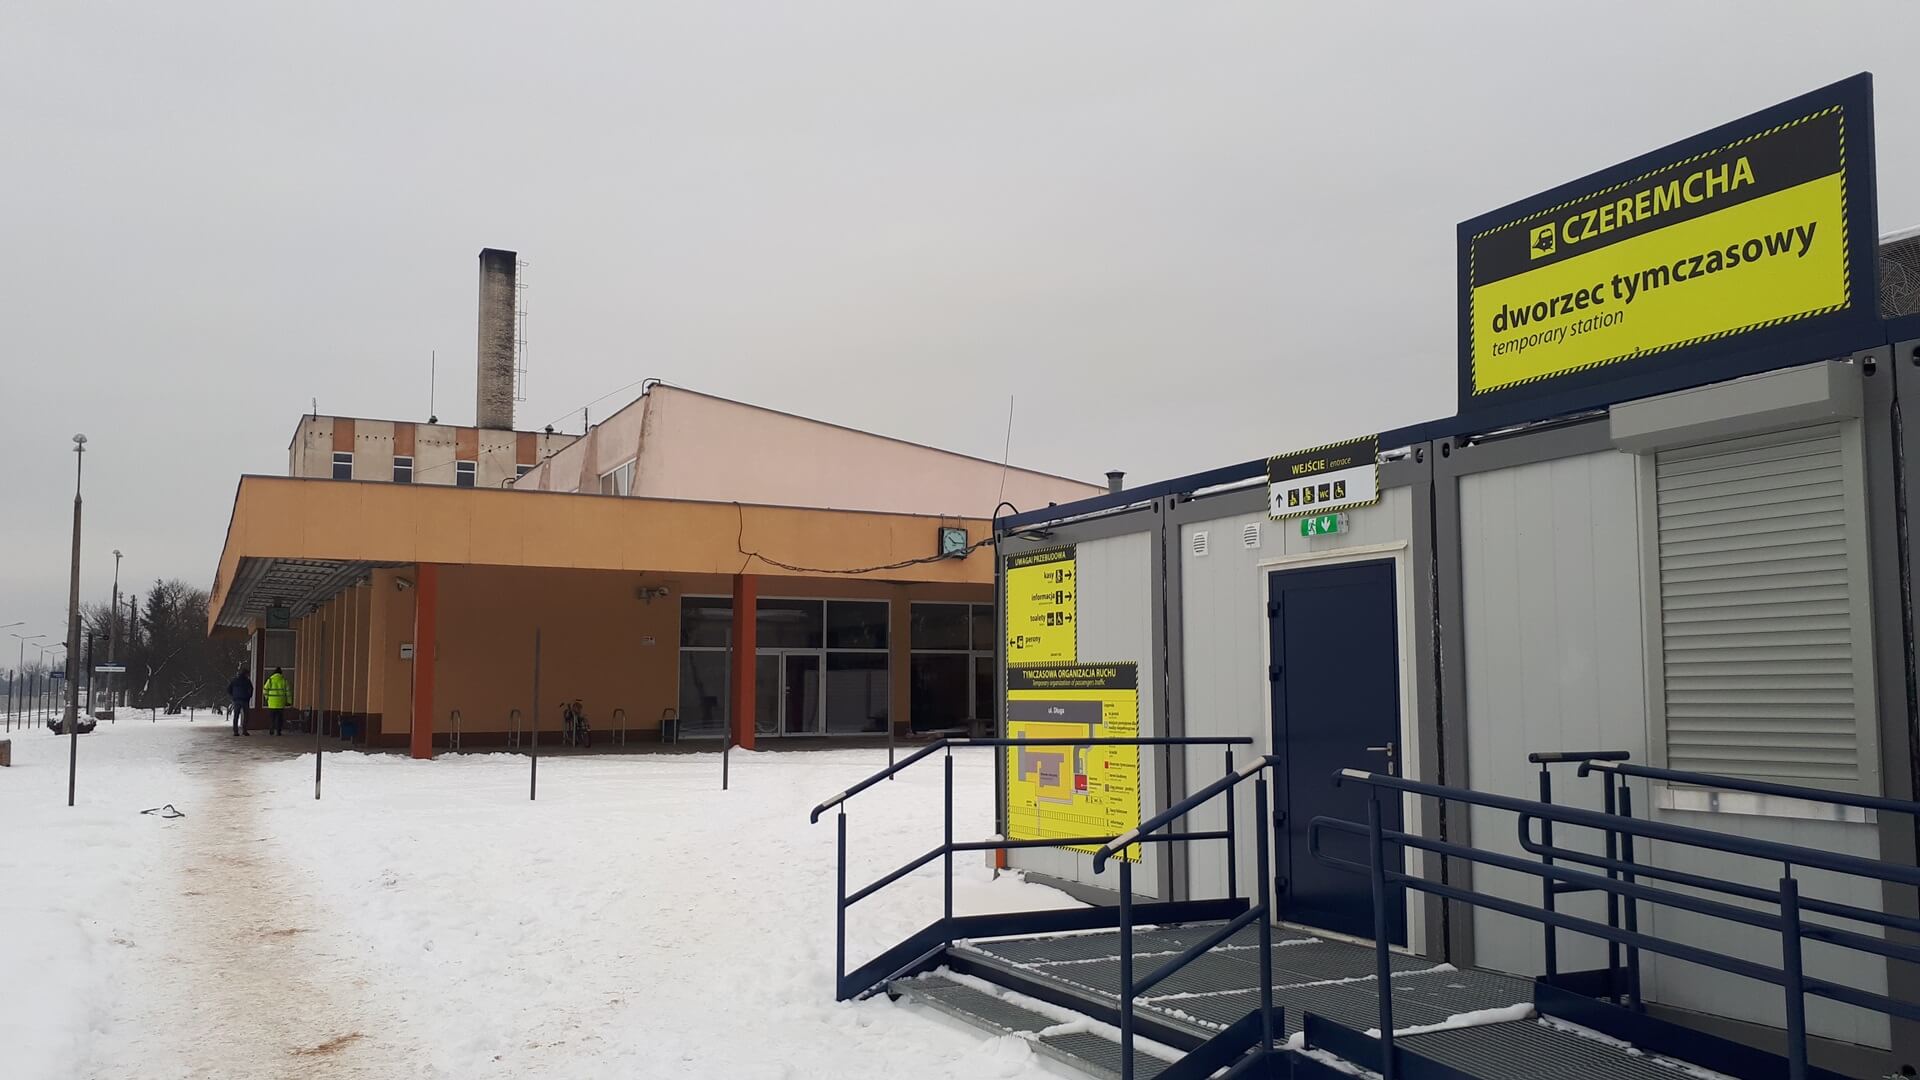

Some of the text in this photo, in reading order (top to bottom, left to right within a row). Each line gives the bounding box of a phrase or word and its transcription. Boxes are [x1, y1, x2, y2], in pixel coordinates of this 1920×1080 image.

[1562, 156, 1755, 246] CZEREMCHA
[1492, 220, 1818, 333] dworzec tymczasowy
[1491, 309, 1624, 357] temporary station
[1291, 459, 1325, 475] WEJŚCIE
[1319, 489, 1329, 498] WC
[1033, 552, 1066, 564] PRZEBUDOWA
[1044, 572, 1054, 580] kasy
[1031, 592, 1056, 602] informacja
[1030, 614, 1046, 623] toalety
[1025, 635, 1041, 644] perony
[1022, 668, 1117, 679] TYMCZASOWA ORGANIZACJA RUCHU
